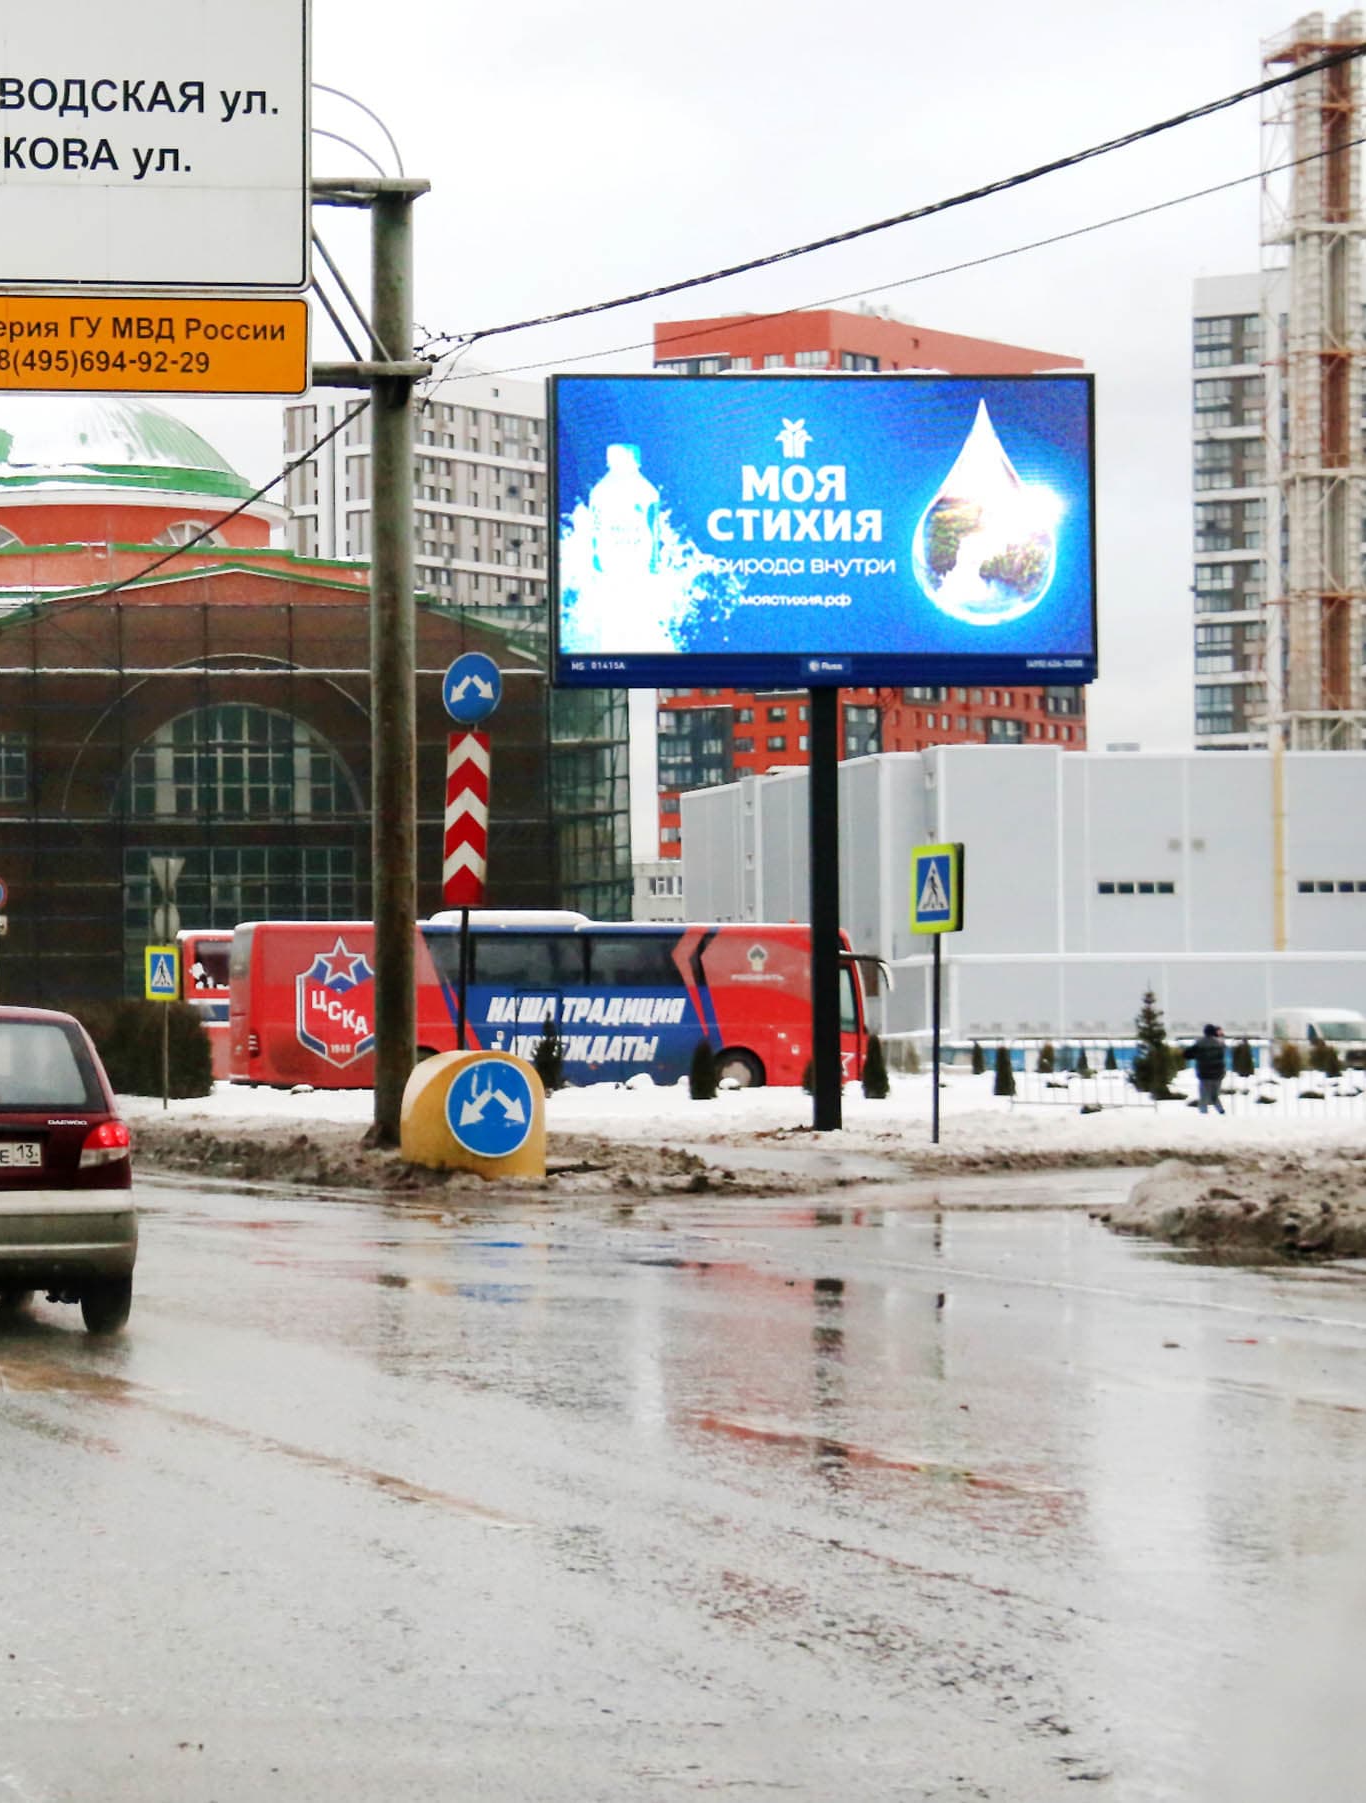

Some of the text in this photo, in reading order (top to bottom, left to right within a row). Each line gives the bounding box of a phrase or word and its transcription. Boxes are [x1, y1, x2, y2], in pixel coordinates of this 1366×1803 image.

[219, 90, 278, 123] ул.
[132, 147, 191, 180] ул.
[70, 316, 102, 339] ГУ
[112, 316, 175, 344] МВД
[185, 317, 285, 341] России
[741, 464, 847, 503] МОЯ
[706, 508, 883, 542] СТИХИЯ
[712, 556, 897, 578] рирода внутри
[311, 990, 369, 1035] ЦСКА
[486, 996, 686, 1027] НАША ТРАДИЦИЯ
[508, 1034, 659, 1064] ПОЕЖДАТЬ!
[17, 1144, 34, 1160] 13
